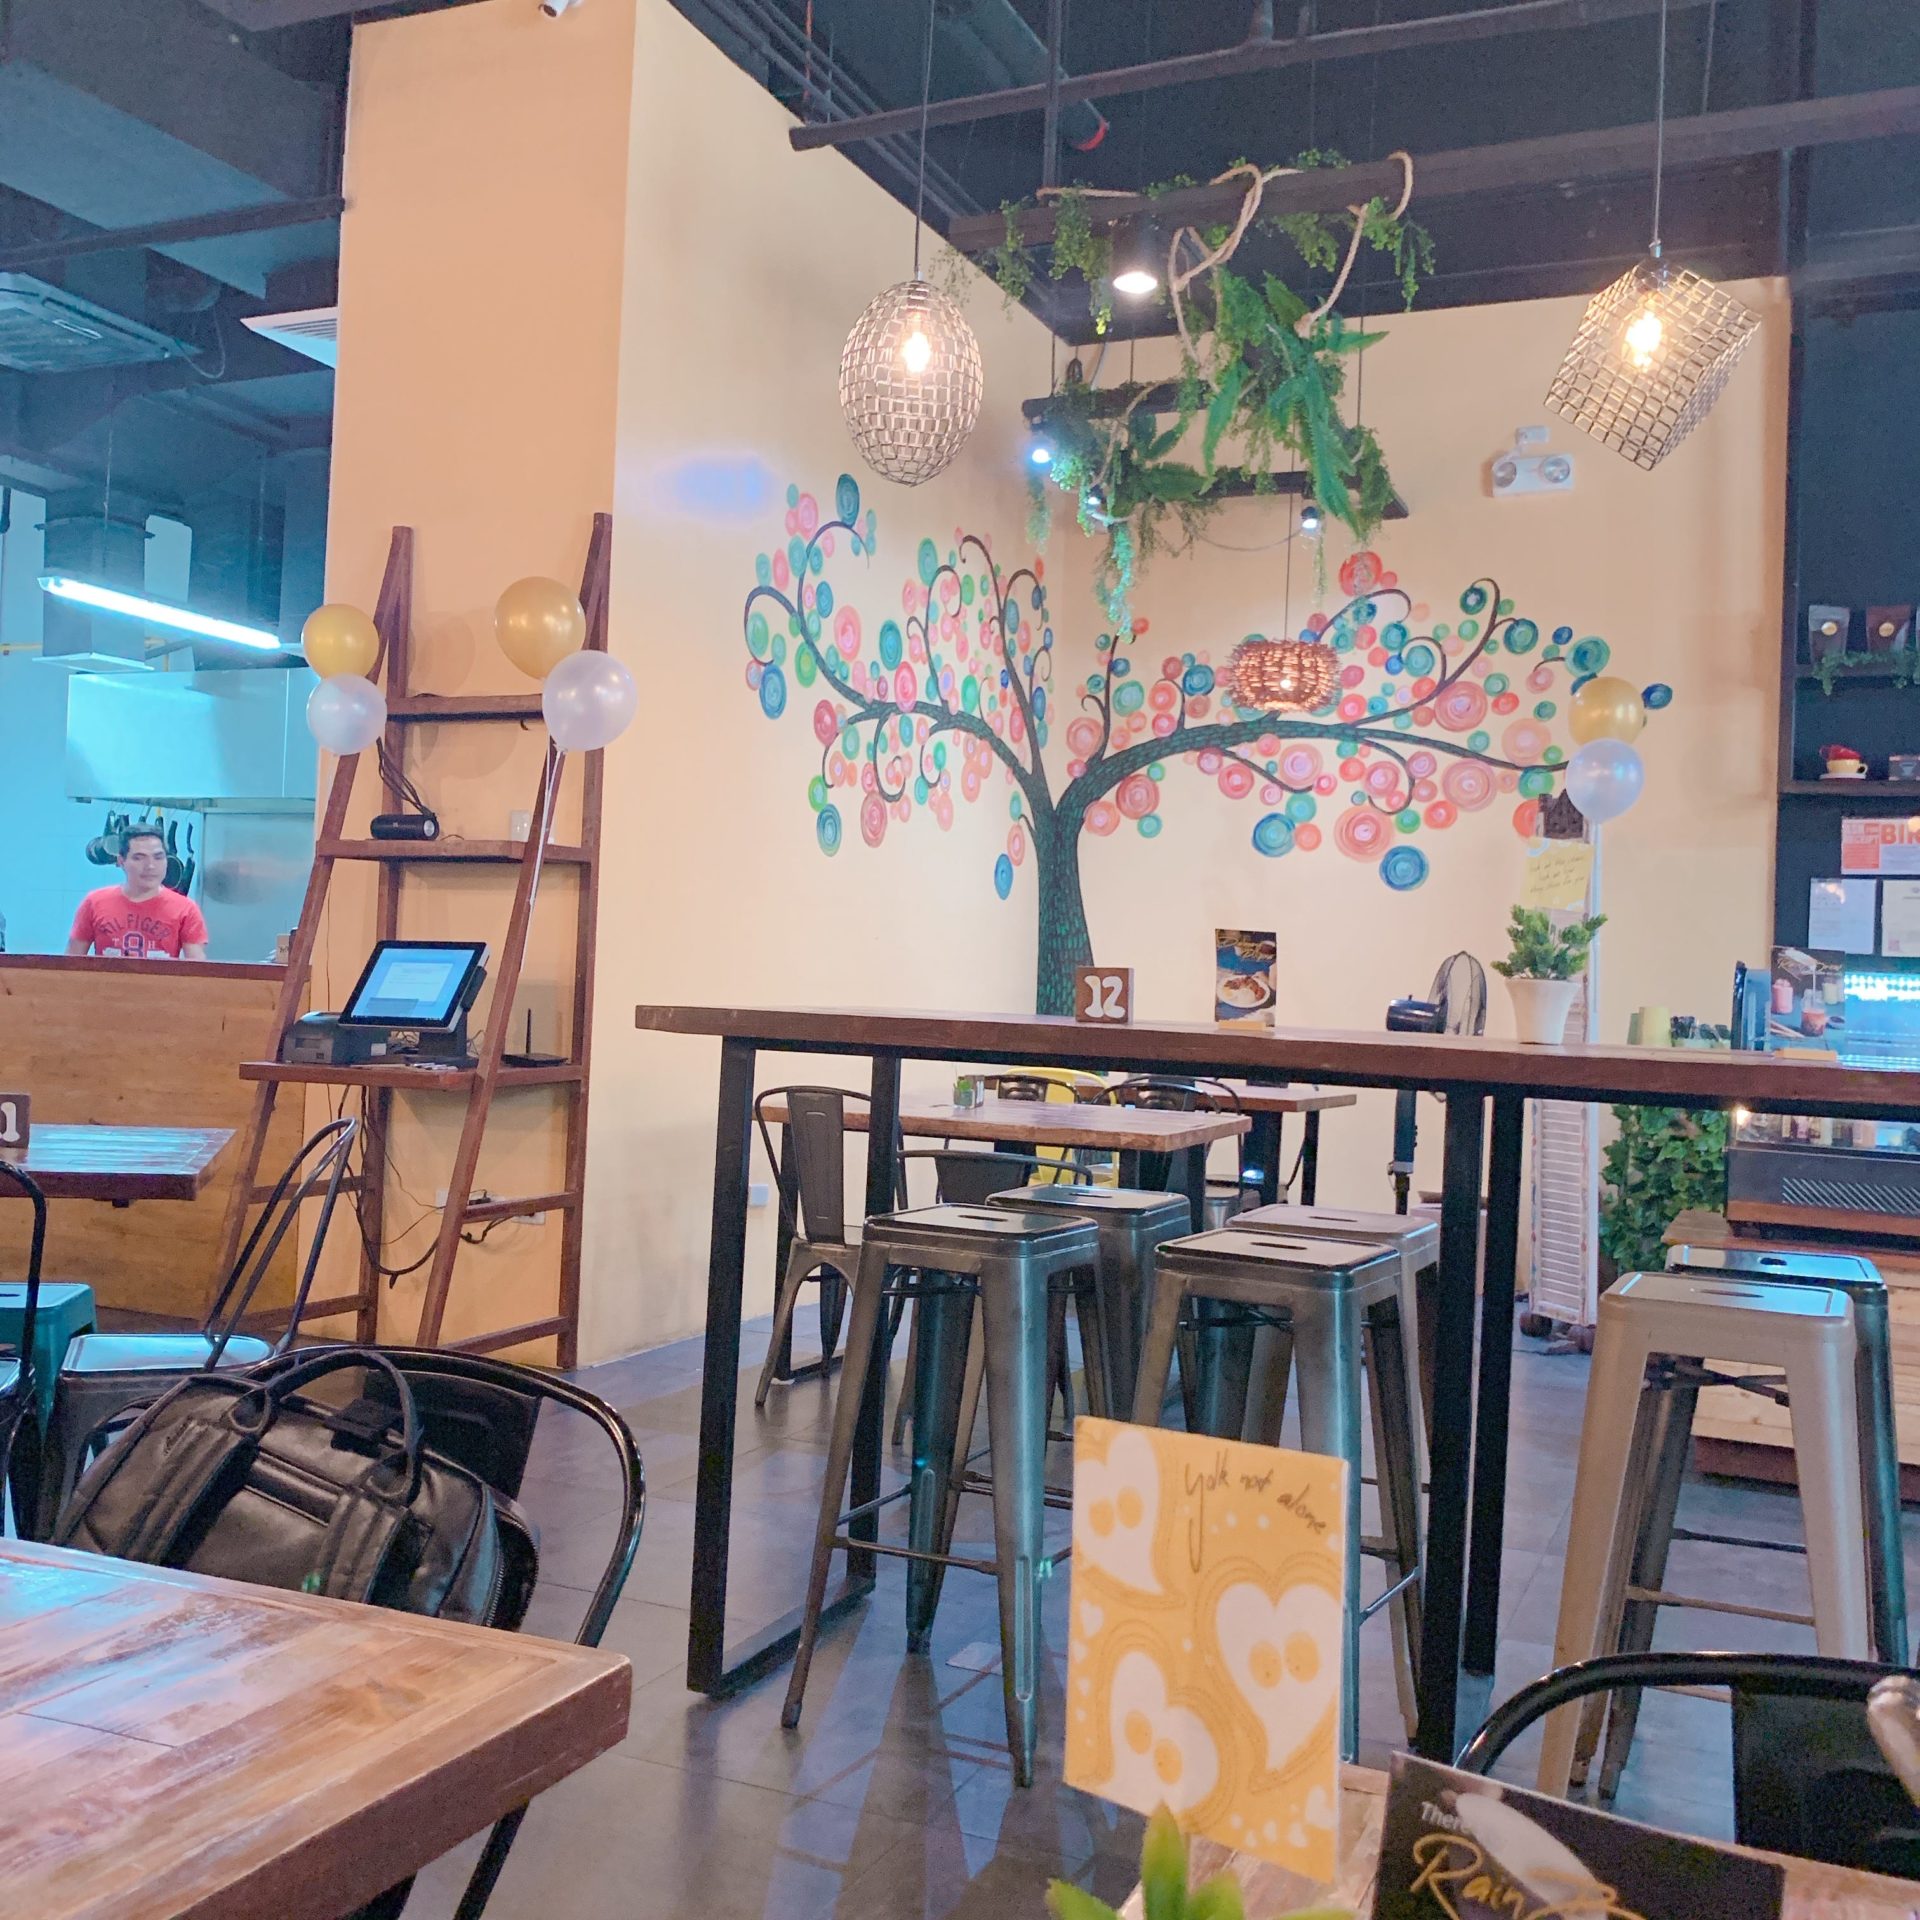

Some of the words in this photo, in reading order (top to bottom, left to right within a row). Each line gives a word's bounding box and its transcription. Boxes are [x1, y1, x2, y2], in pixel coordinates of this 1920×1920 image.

[1083, 975, 1126, 1019] 12
[0, 1101, 20, 1142] 1
[1239, 1467, 1275, 1493] not
[1276, 1482, 1328, 1535] alone
